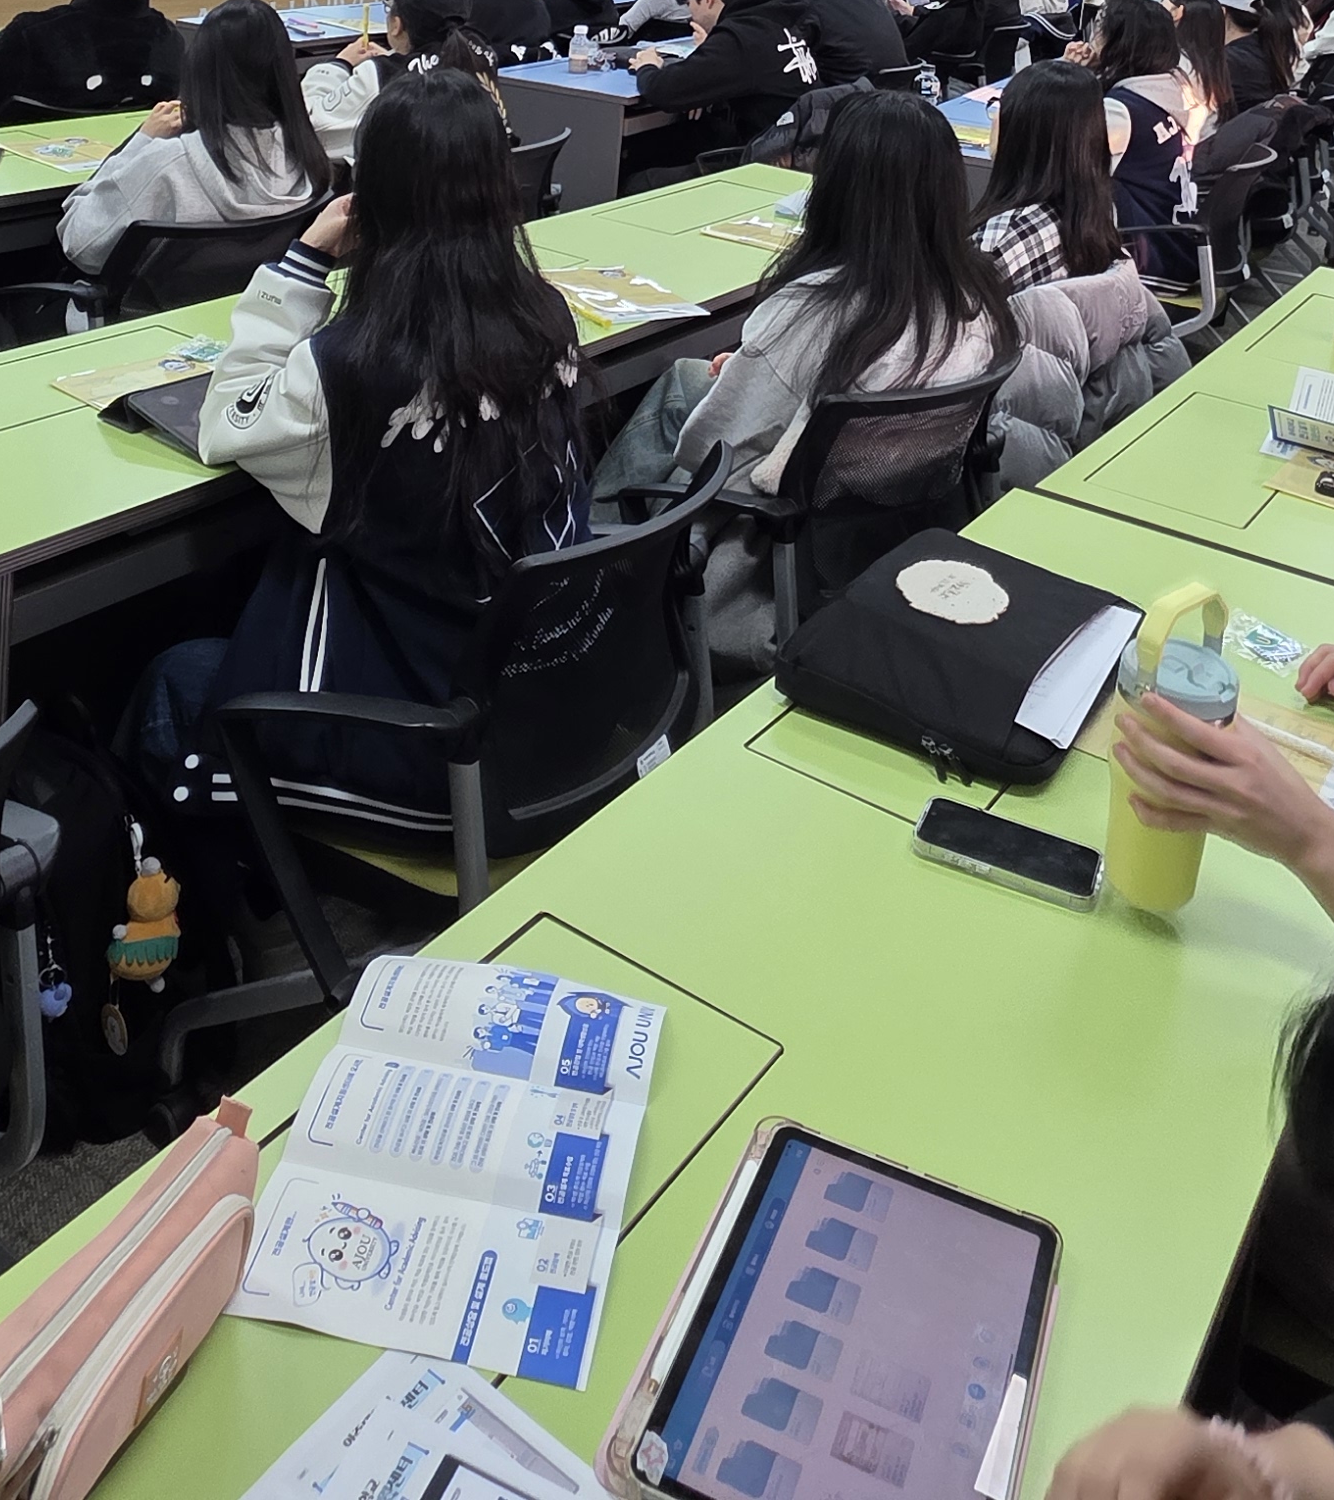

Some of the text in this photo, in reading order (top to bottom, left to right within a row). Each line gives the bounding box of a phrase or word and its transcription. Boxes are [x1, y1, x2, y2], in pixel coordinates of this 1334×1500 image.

[624, 1030, 649, 1079] AJOU
[559, 1057, 571, 1074] 05
[367, 1086, 383, 1112] Academic
[363, 1113, 372, 1122] for
[553, 1113, 563, 1125] 04
[355, 1122, 368, 1144] Center
[543, 1183, 556, 1202] 03
[351, 1233, 371, 1269] AJOU
[383, 1216, 426, 1310] Center for Academic Advising
[536, 1257, 549, 1272] 02
[526, 1337, 539, 1353] 01
